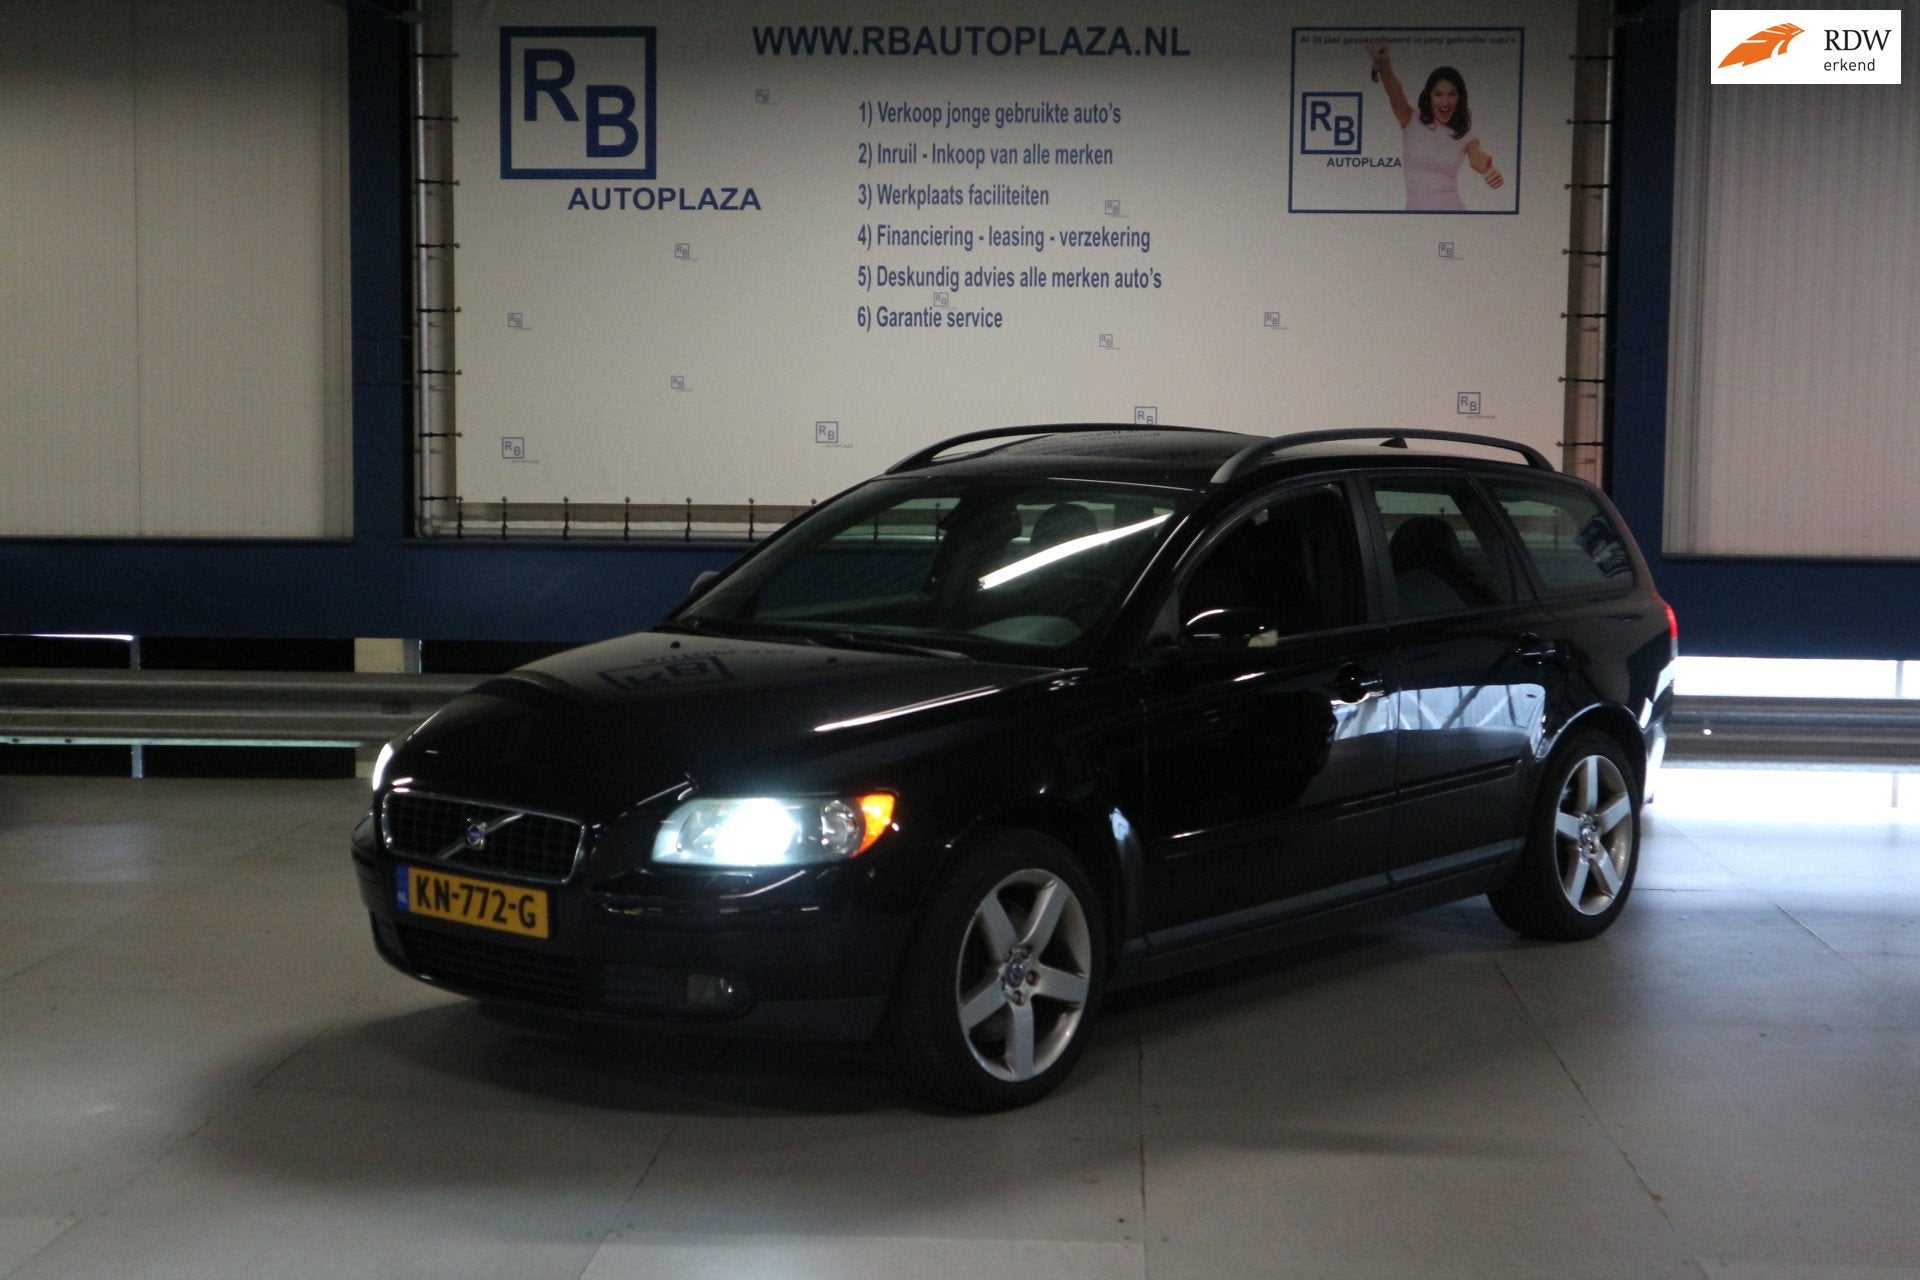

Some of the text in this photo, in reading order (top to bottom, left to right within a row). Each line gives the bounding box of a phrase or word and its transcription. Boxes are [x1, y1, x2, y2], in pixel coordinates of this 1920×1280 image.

[752, 26, 1190, 56] WWW.RBAUTOPLAZA.NL
[523, 48, 639, 158] RB
[859, 101, 1121, 128] 1) Verkoop jonge gebruikte auto's
[1310, 100, 1356, 146] RB
[859, 142, 872, 167] 2)
[877, 143, 917, 164] Inruil
[932, 143, 985, 168] Inkoop
[990, 148, 1018, 164] van
[1023, 143, 1050, 164] alle
[1055, 144, 1113, 164] merken
[1326, 157, 1402, 168] AUTOPLAZA
[568, 187, 760, 210] AUTOPLAZA
[859, 183, 1049, 209] 3) Werkplaats faciliteiten
[858, 225, 872, 249] 4)
[877, 224, 973, 252] Financiering
[989, 226, 1044, 252] leasing
[1060, 226, 1150, 253] verzekering
[858, 265, 1162, 292] 5) Deskundig advies alle merken auto's
[857, 306, 1002, 331] 6) Garantie service
[416, 874, 536, 929] KN-772-G
